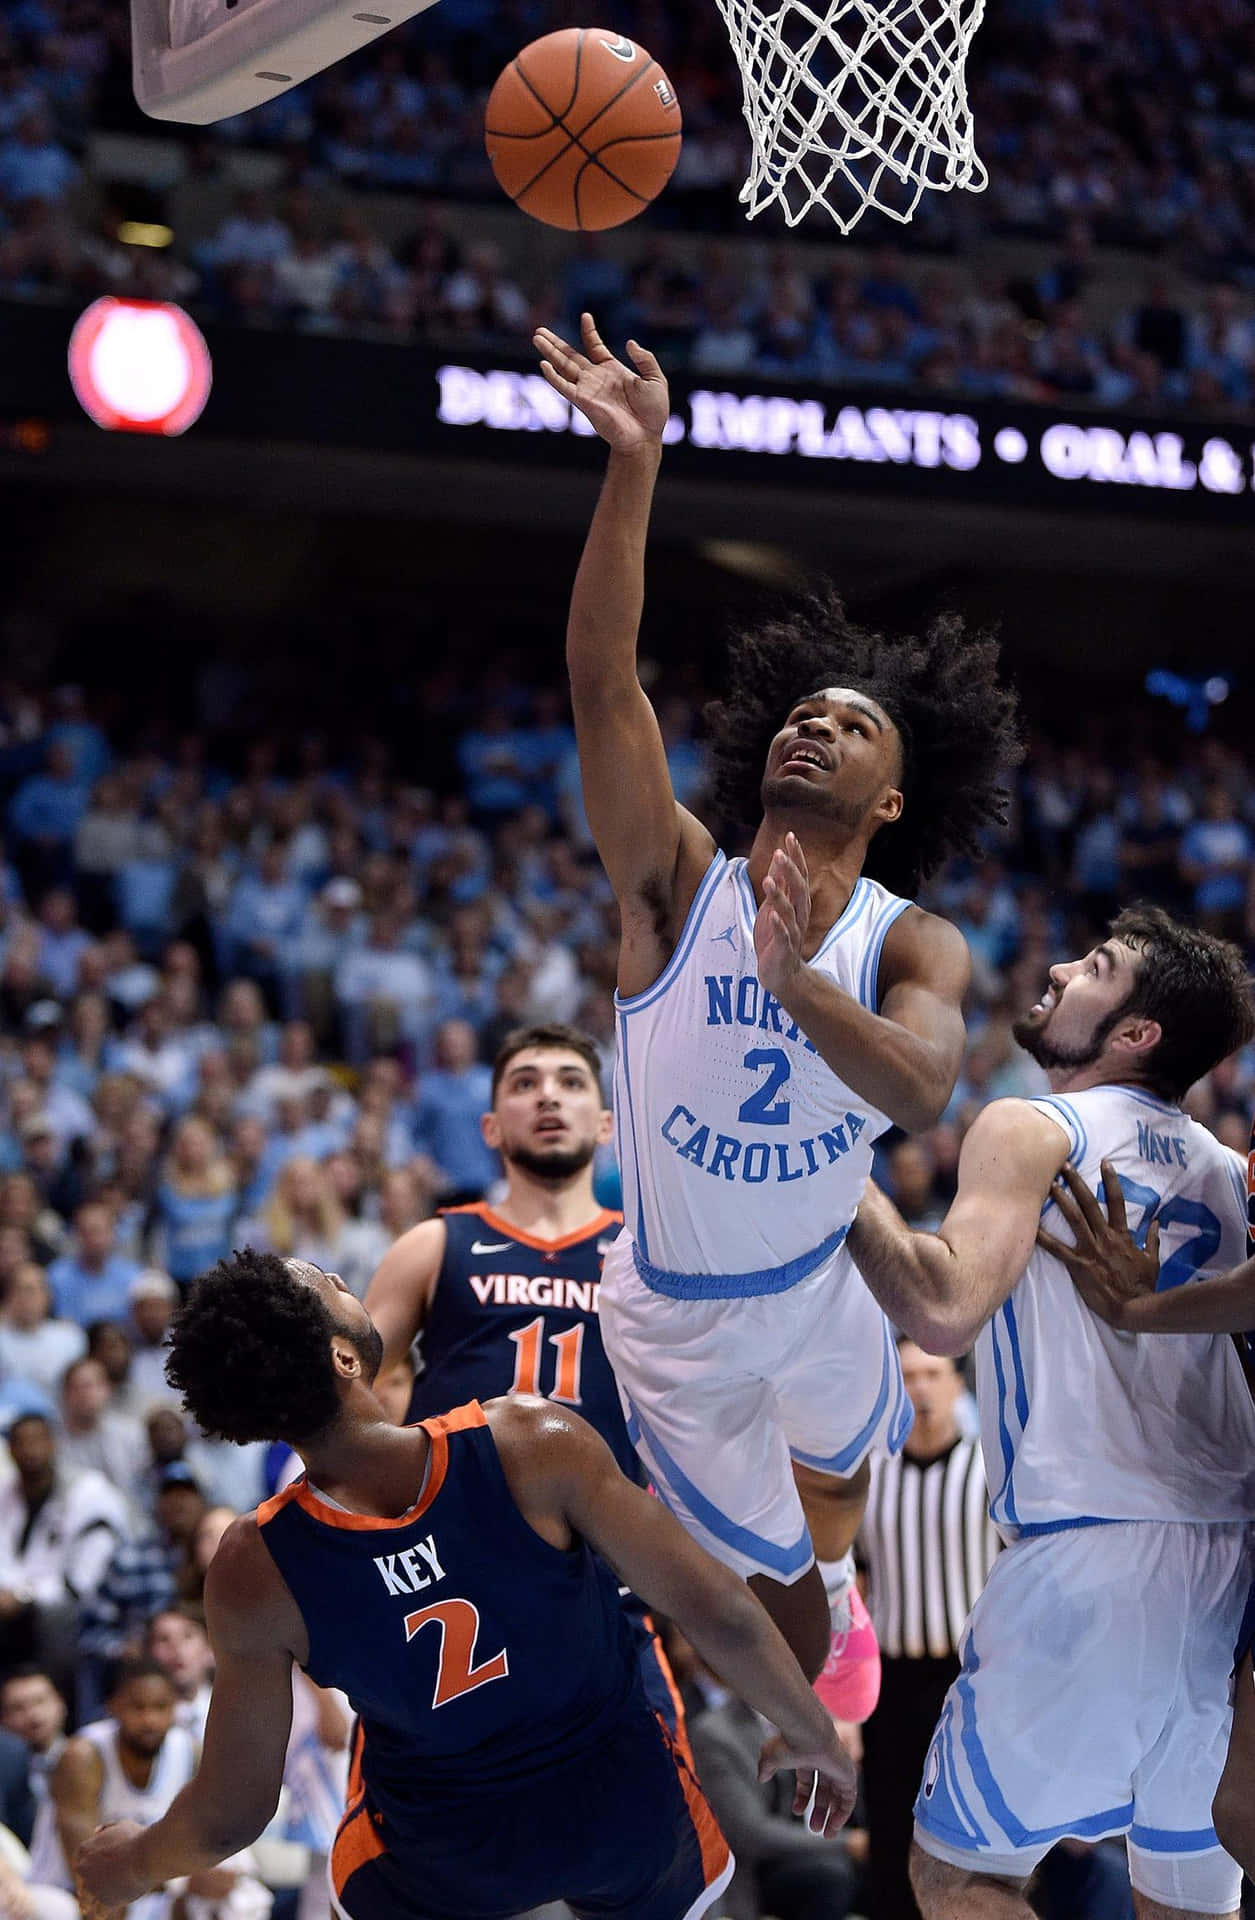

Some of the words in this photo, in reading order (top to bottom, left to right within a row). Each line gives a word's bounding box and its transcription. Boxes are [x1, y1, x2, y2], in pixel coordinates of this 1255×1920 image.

[688, 390, 981, 471] IMPLANTS
[1040, 423, 1197, 490] ORAL
[1200, 437, 1245, 494] &
[704, 975, 820, 1056] NOR
[738, 1048, 791, 1126] 2
[661, 1104, 866, 1183] CAROLINA
[508, 1315, 585, 1405] 11
[373, 1534, 447, 1596] KEY
[403, 1598, 509, 1710] 2
